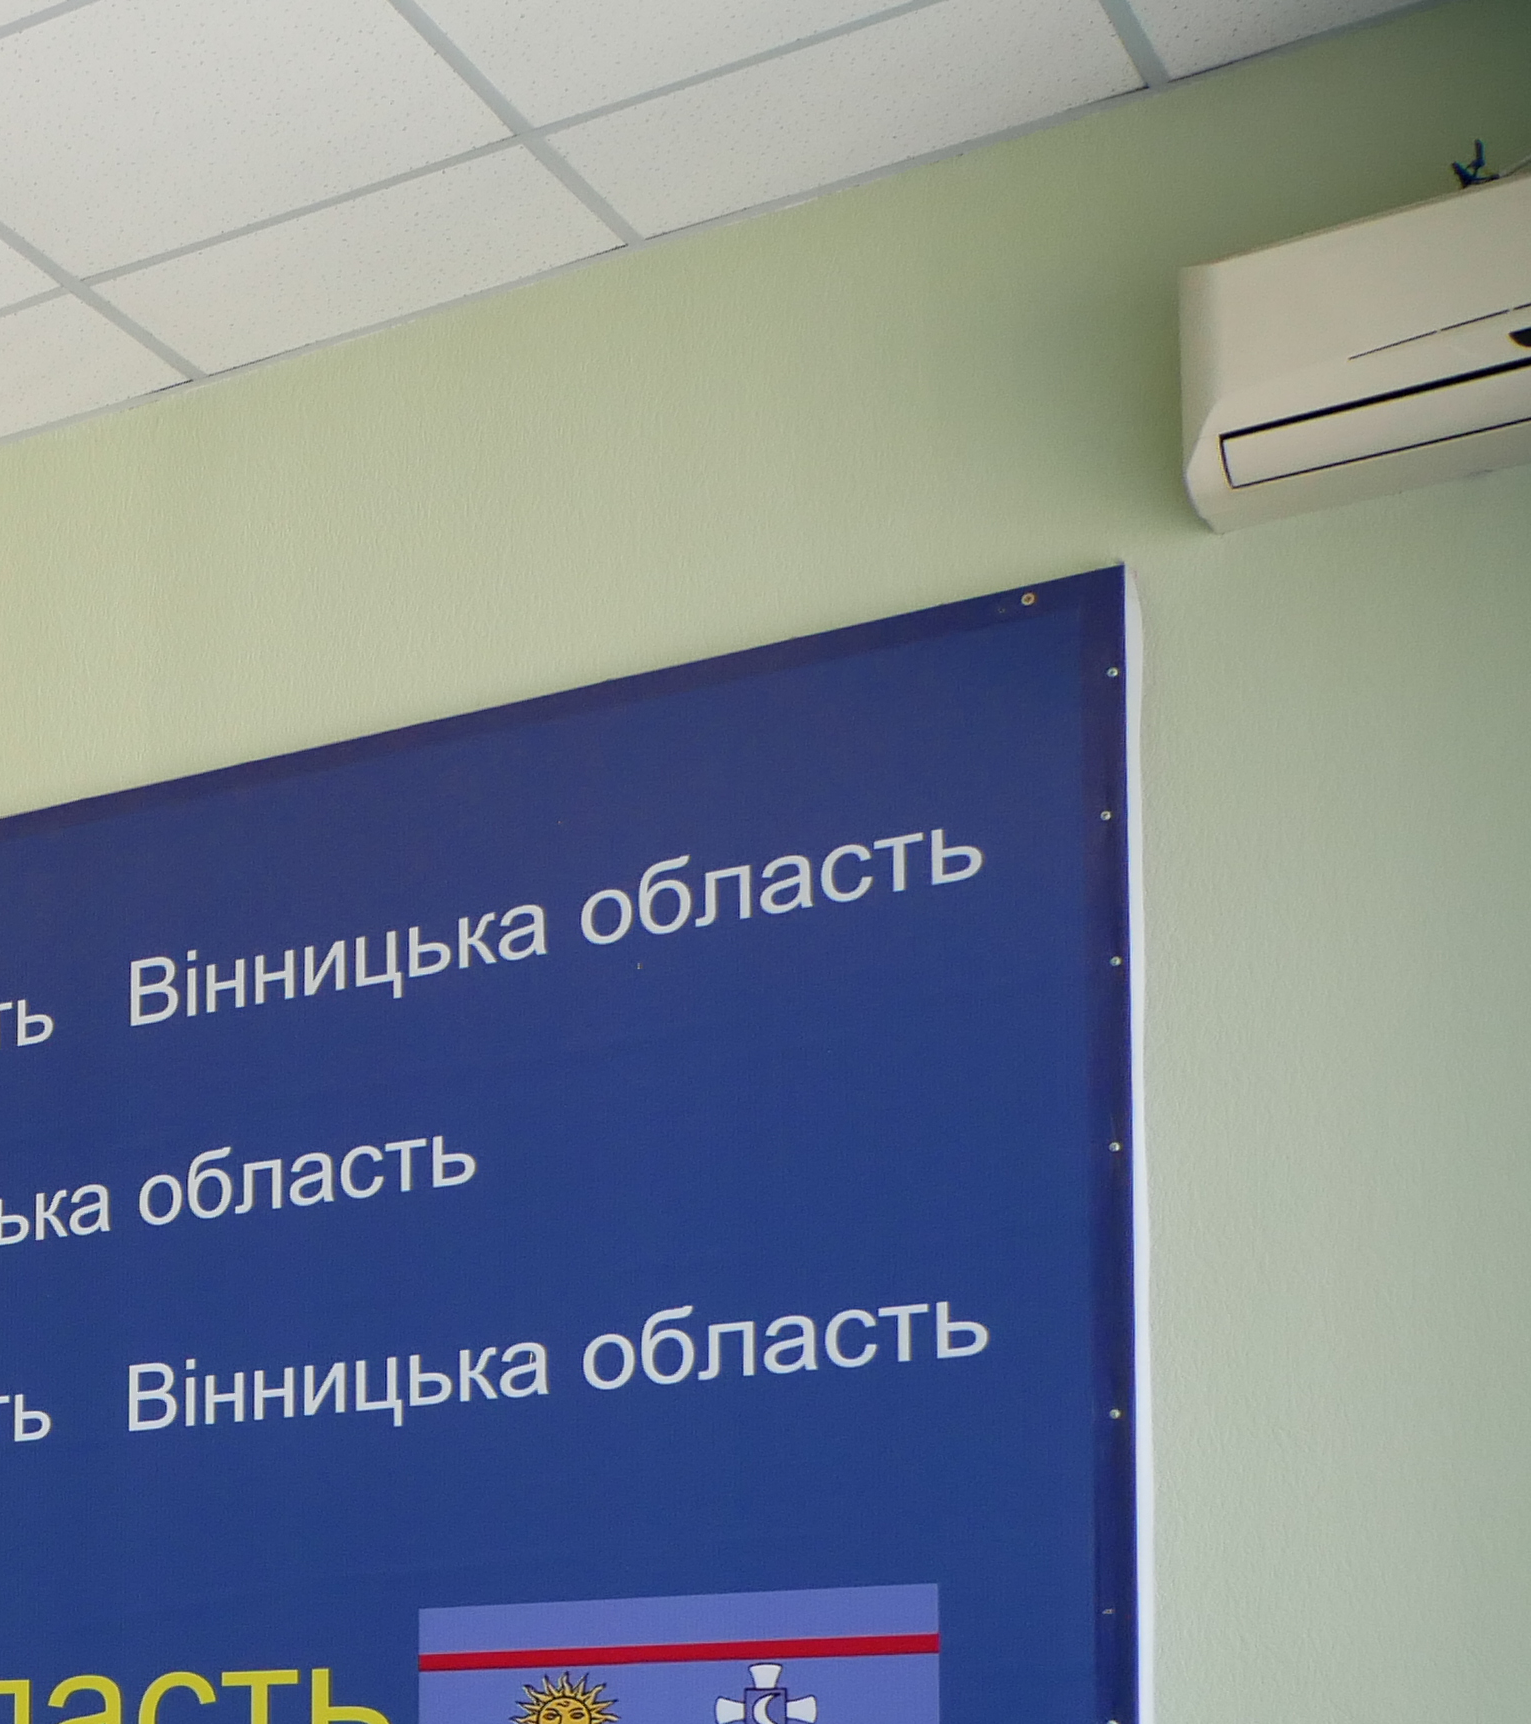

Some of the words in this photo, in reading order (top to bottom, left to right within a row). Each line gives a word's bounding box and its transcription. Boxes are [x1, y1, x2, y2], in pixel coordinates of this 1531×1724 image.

[130, 904, 548, 1027] Вінницька
[580, 828, 984, 945] область
[138, 1135, 477, 1226] область
[128, 1341, 549, 1432] Вінницька
[582, 1300, 990, 1390] область
